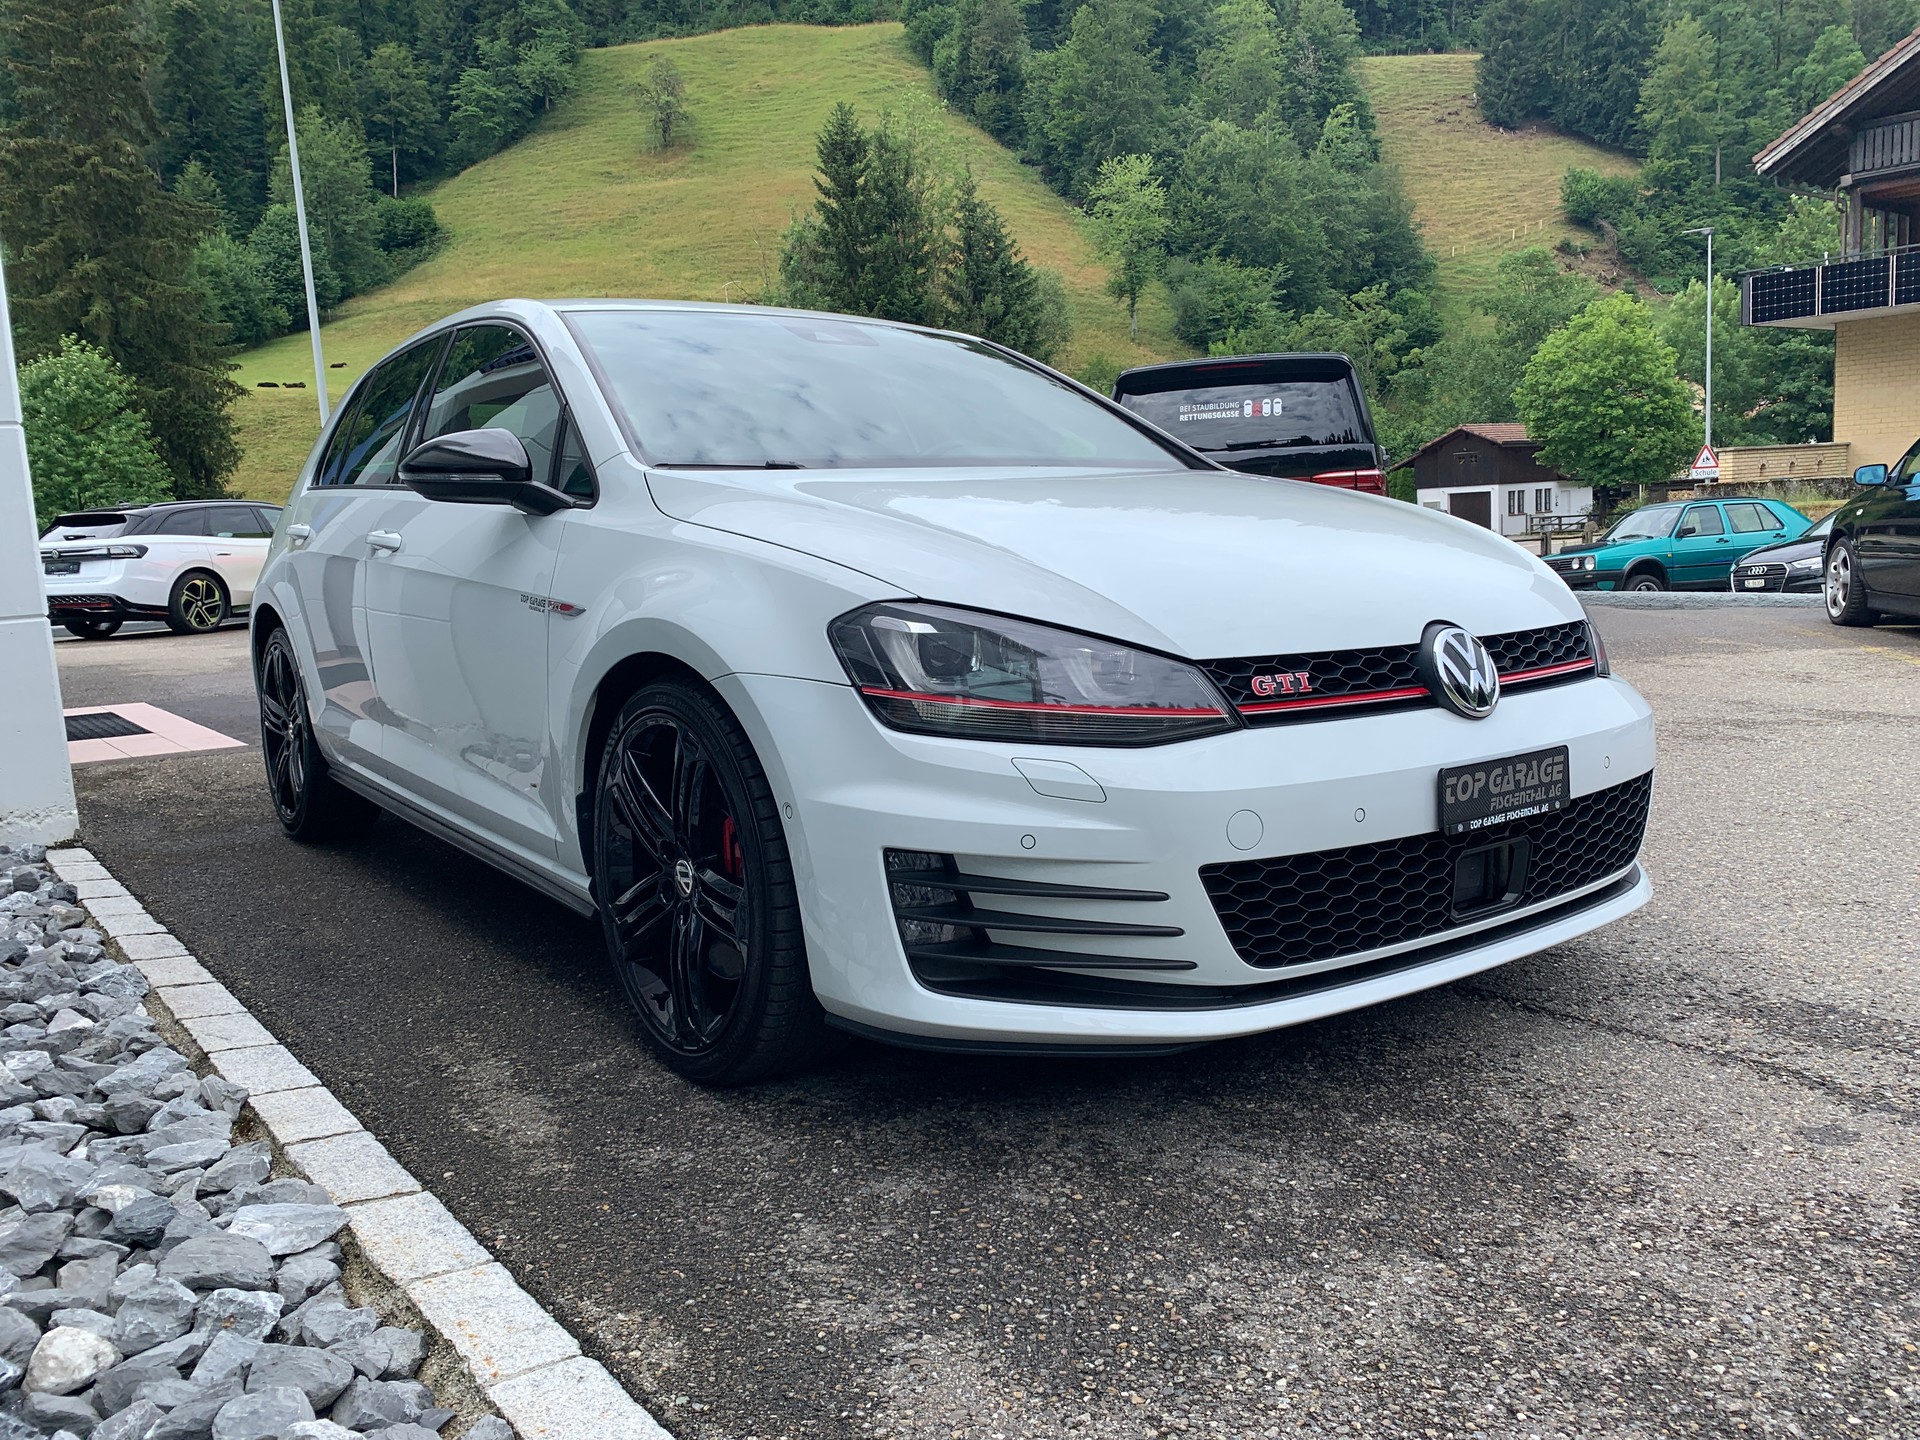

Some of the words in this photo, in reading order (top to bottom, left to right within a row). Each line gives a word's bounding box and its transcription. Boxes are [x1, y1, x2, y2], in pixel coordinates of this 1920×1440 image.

[1179, 405, 1190, 413] BEI
[1192, 401, 1240, 412] STAUBILDUNG
[1179, 410, 1240, 421] RETTUNGSGASSE
[1695, 469, 1717, 477] Schule
[1251, 671, 1313, 697] GTI
[1445, 771, 1486, 804] TOP
[1489, 755, 1564, 794] GARAGE
[1490, 786, 1547, 811] FISCHENTHAL
[1549, 783, 1562, 798] AG
[1470, 820, 1482, 829] TOP
[1483, 813, 1506, 826] GARAGE
[1506, 805, 1540, 821] FISCHENTHAL
[1541, 803, 1549, 813] AG
